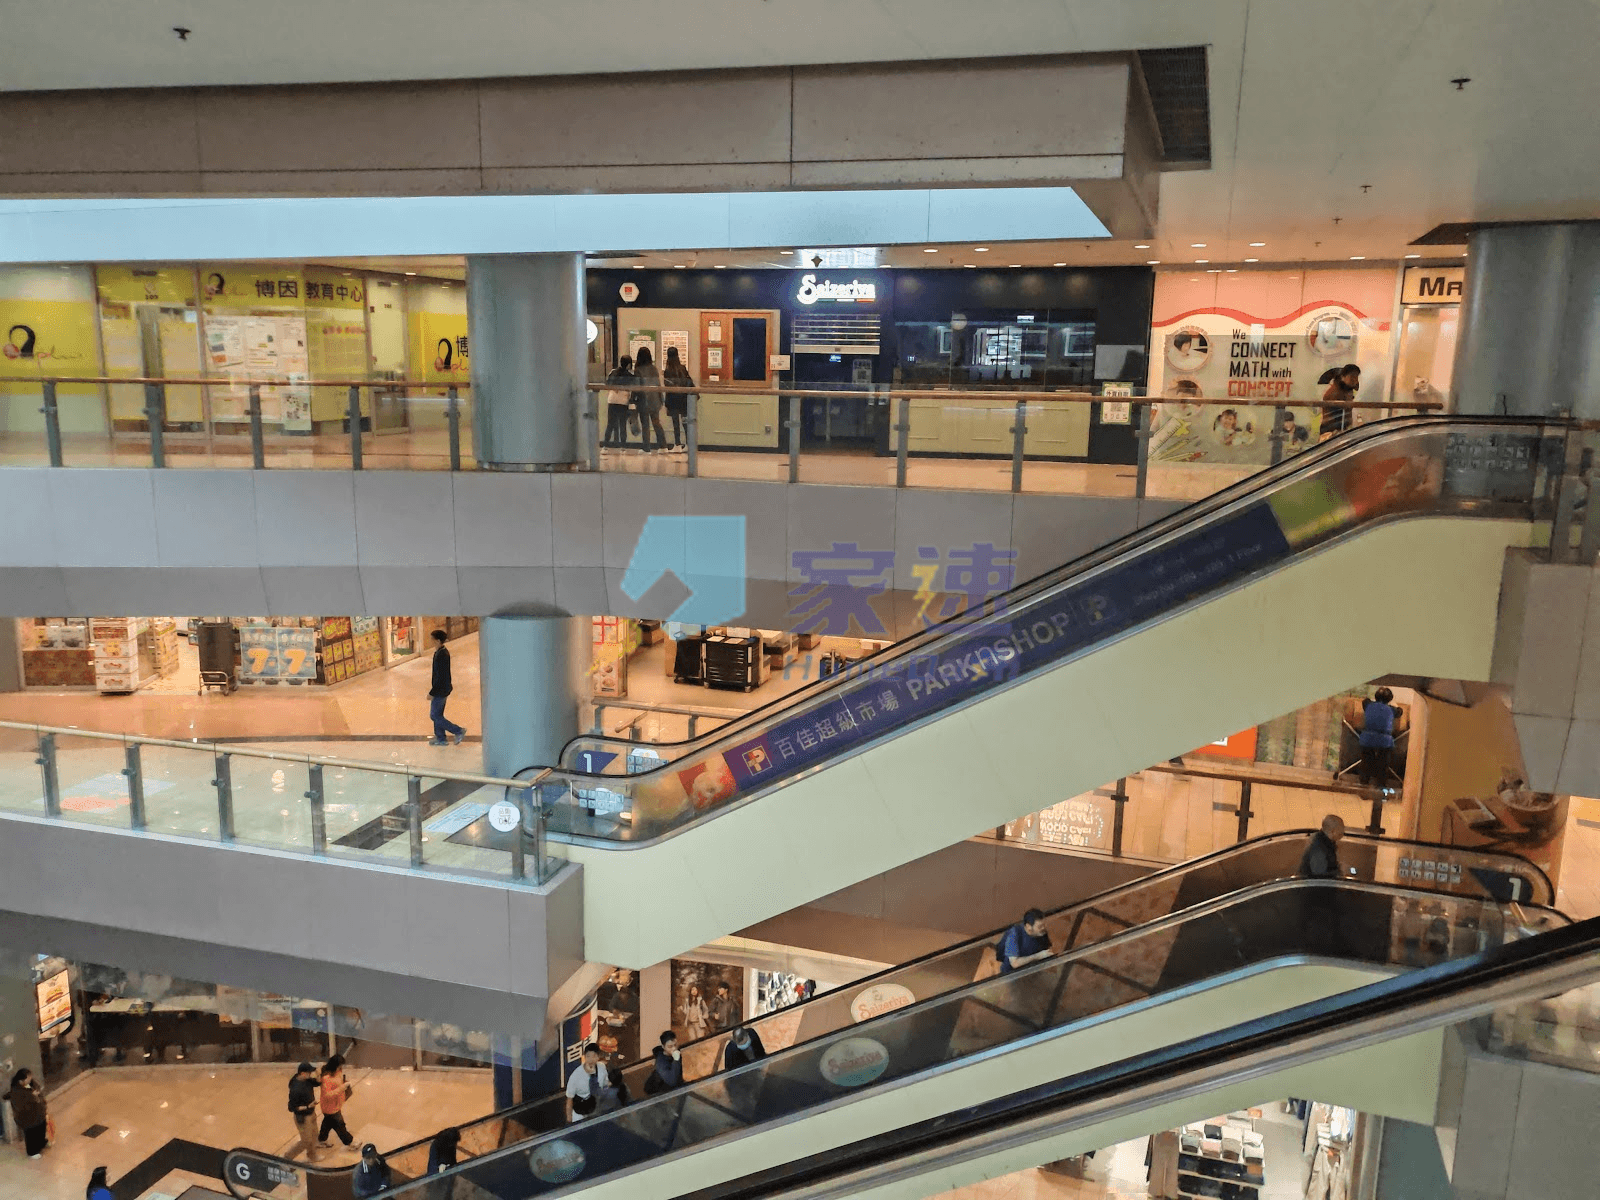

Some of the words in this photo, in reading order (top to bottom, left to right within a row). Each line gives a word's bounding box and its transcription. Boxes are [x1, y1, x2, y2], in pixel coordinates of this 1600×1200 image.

[1232, 328, 1246, 340] We
[1230, 342, 1297, 358] CONNECT
[1229, 361, 1270, 378] MATH
[1271, 366, 1292, 378] with
[1228, 380, 1294, 398] CONCEPT
[774, 690, 900, 760] 百佳超級市場
[583, 753, 592, 773] 1
[1508, 877, 1522, 901] 1
[235, 1162, 251, 1181] G
